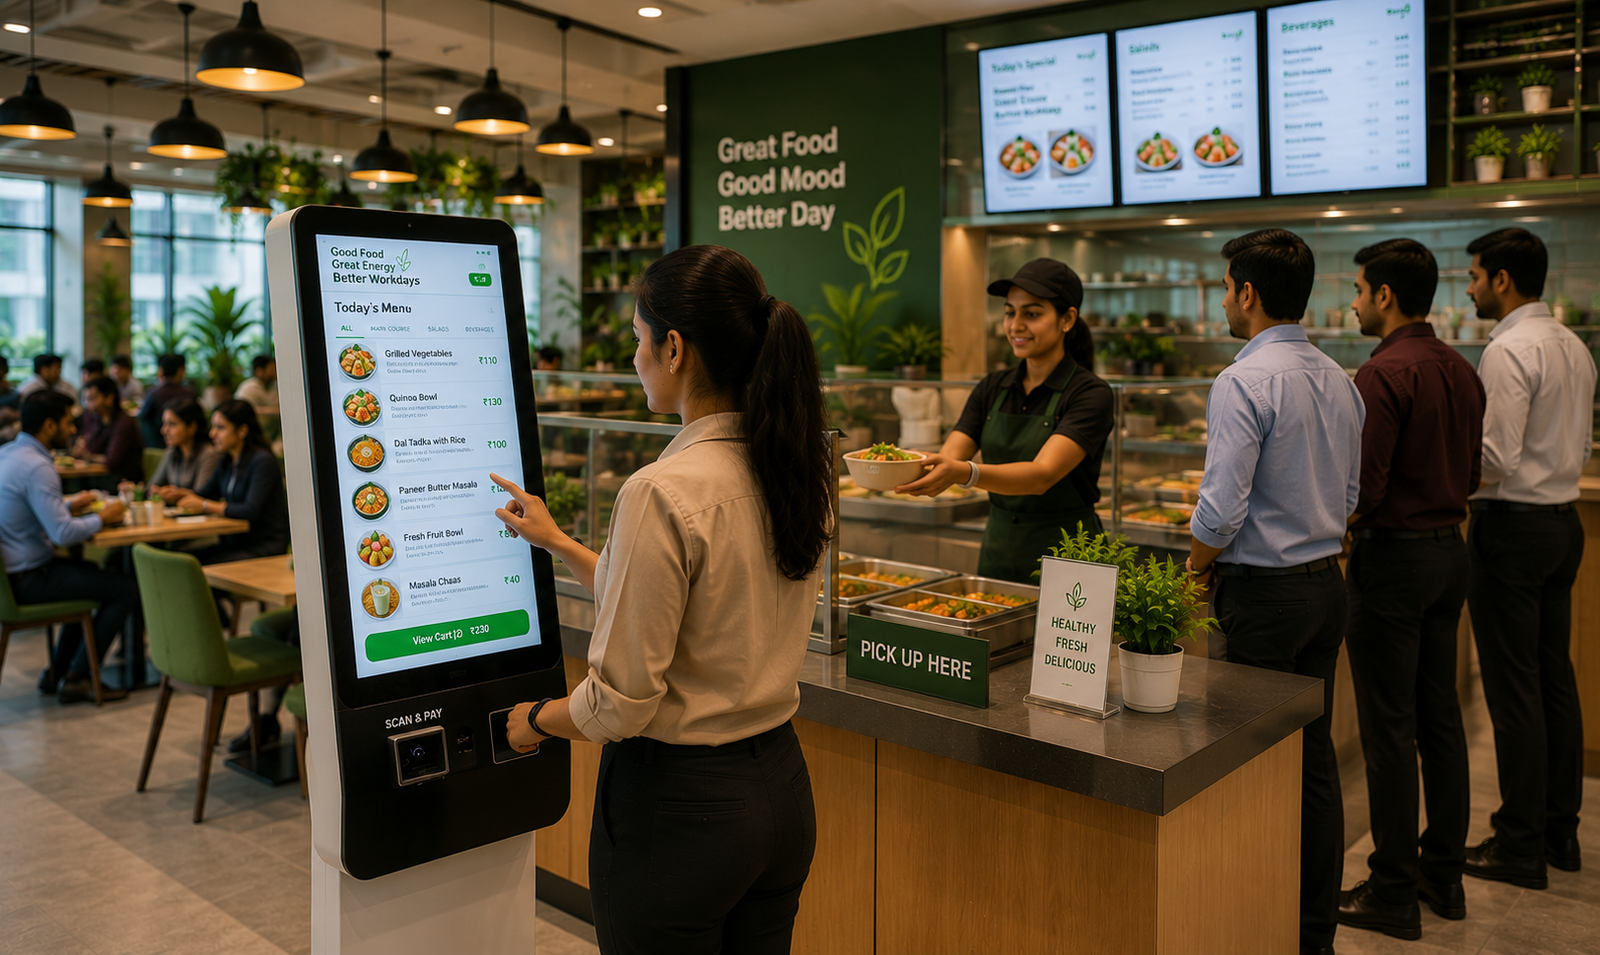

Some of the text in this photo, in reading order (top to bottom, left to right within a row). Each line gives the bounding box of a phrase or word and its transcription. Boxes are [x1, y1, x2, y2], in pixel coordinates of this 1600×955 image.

[718, 125, 838, 164] Great Food
[718, 160, 846, 198] Good Mood
[718, 200, 836, 231] Better Day
[330, 246, 384, 259] Good Food
[331, 259, 396, 273] Great Energy
[333, 272, 421, 287] Better Workdays
[334, 301, 412, 315] Today's Menu
[384, 349, 498, 365] Grilled Vegetables ₹110
[389, 393, 502, 406] Quinoa Bowl ₹130
[394, 436, 507, 449] Dal Tadka with Rice ₹100
[398, 485, 426, 495] Paneer
[428, 483, 451, 492] Butter
[452, 481, 478, 490] Masala
[403, 532, 425, 542] Fresh
[426, 530, 444, 540] Fruit
[445, 528, 464, 538] Bowl
[409, 575, 521, 590] Masala Chaas ₹40
[1051, 616, 1097, 635] HEALTHY
[412, 635, 434, 645] View
[434, 631, 453, 641] Cart
[469, 624, 490, 635] ₹230
[1055, 637, 1088, 653] FRESH
[860, 639, 972, 681] PICK UP HERE
[1044, 653, 1096, 675] DELICIOUS
[385, 708, 443, 729] SCAN & PAY
